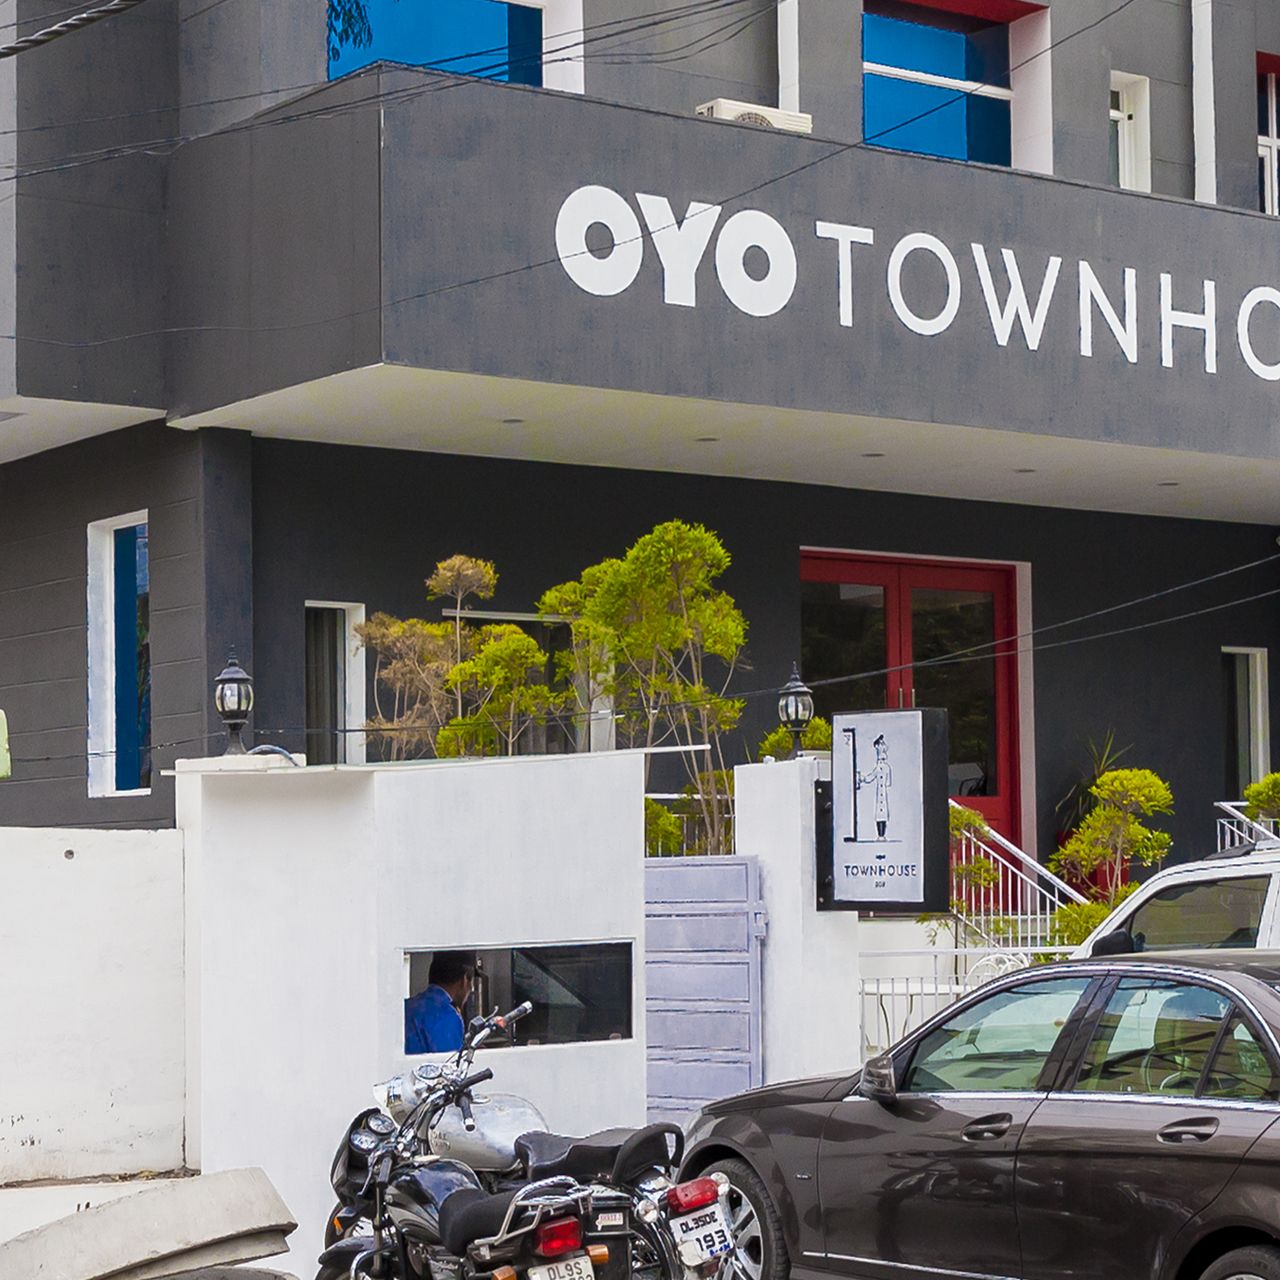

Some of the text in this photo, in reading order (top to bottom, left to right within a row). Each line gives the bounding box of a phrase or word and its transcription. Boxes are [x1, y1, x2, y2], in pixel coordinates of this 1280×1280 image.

[555, 184, 797, 317] OYO
[844, 864, 917, 877] TOWNHOUSE
[695, 1228, 728, 1252] 193
[547, 1261, 583, 1280] DL9S
